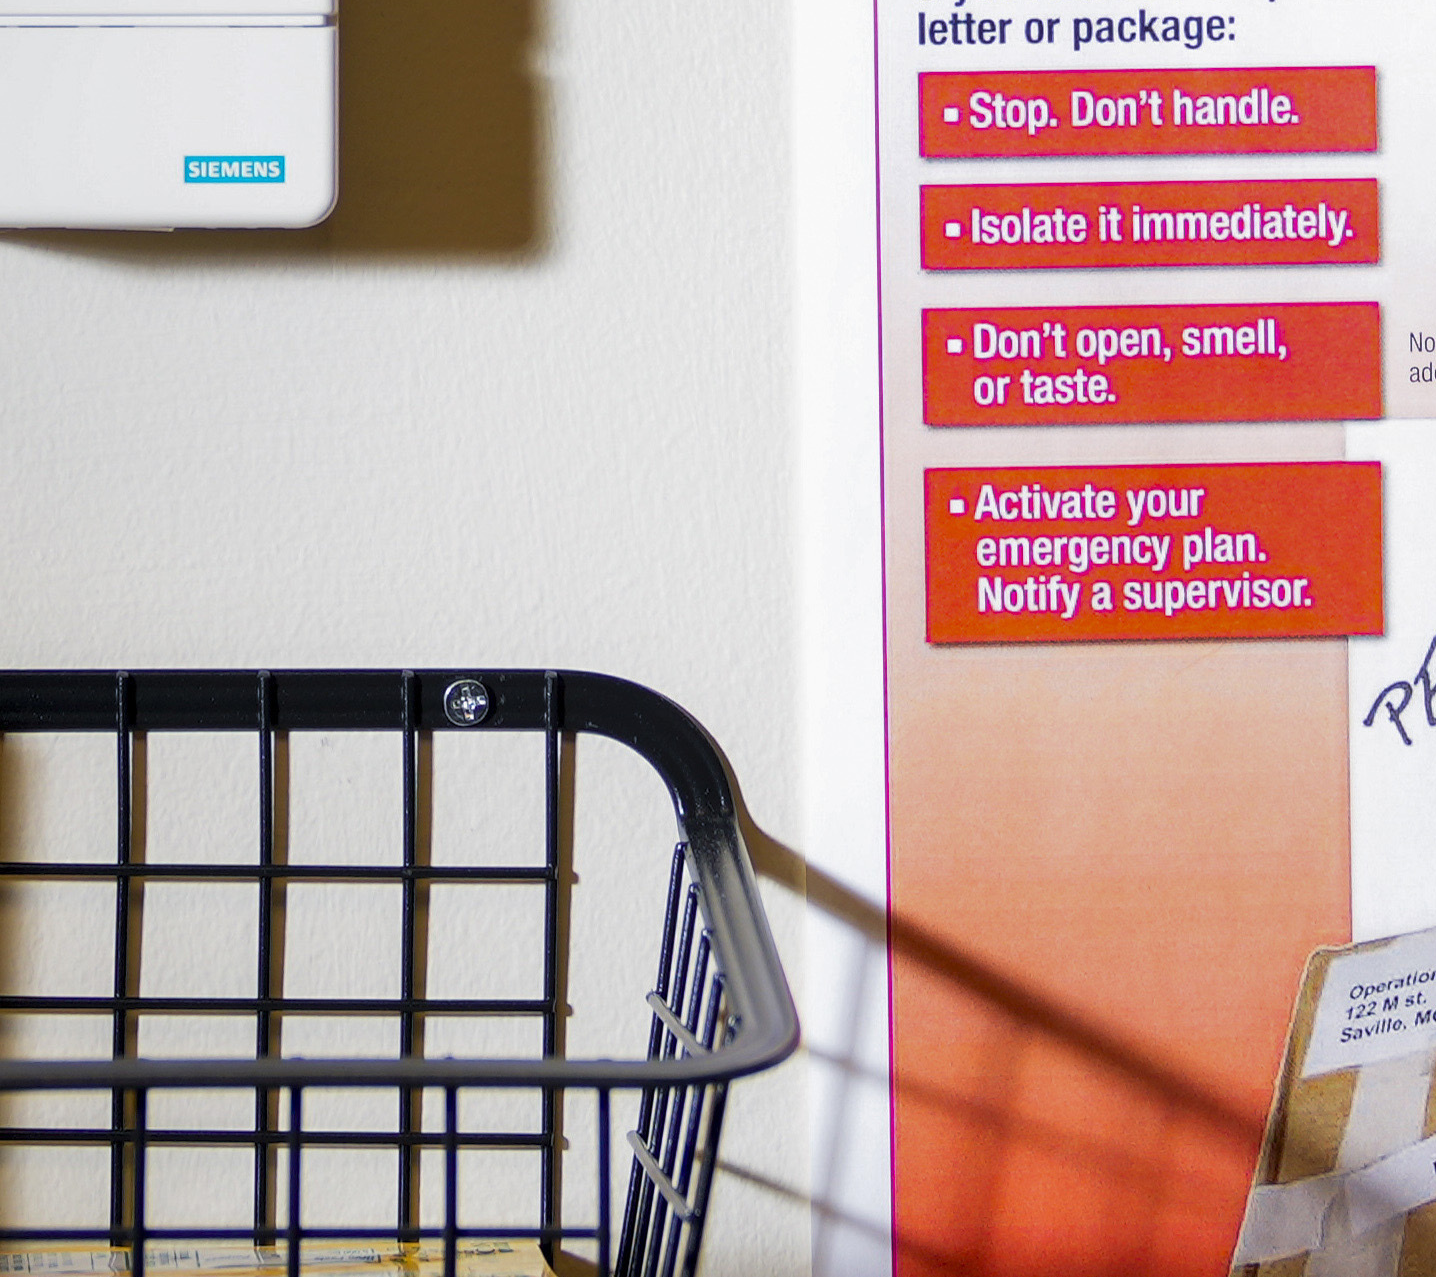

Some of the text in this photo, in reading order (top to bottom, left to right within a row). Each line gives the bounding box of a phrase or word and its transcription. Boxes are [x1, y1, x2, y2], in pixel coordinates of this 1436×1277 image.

[918, 8, 1235, 52] letter or package:
[969, 87, 1300, 134] Stop. Don't handle.
[188, 160, 282, 179] SIEMENS
[973, 318, 1288, 364] Don't open, smell,
[973, 368, 1116, 406] or taste.
[974, 483, 1206, 527] Activate your
[976, 526, 1267, 574] emergency plan.
[977, 571, 1314, 619] Notify a supervisor.
